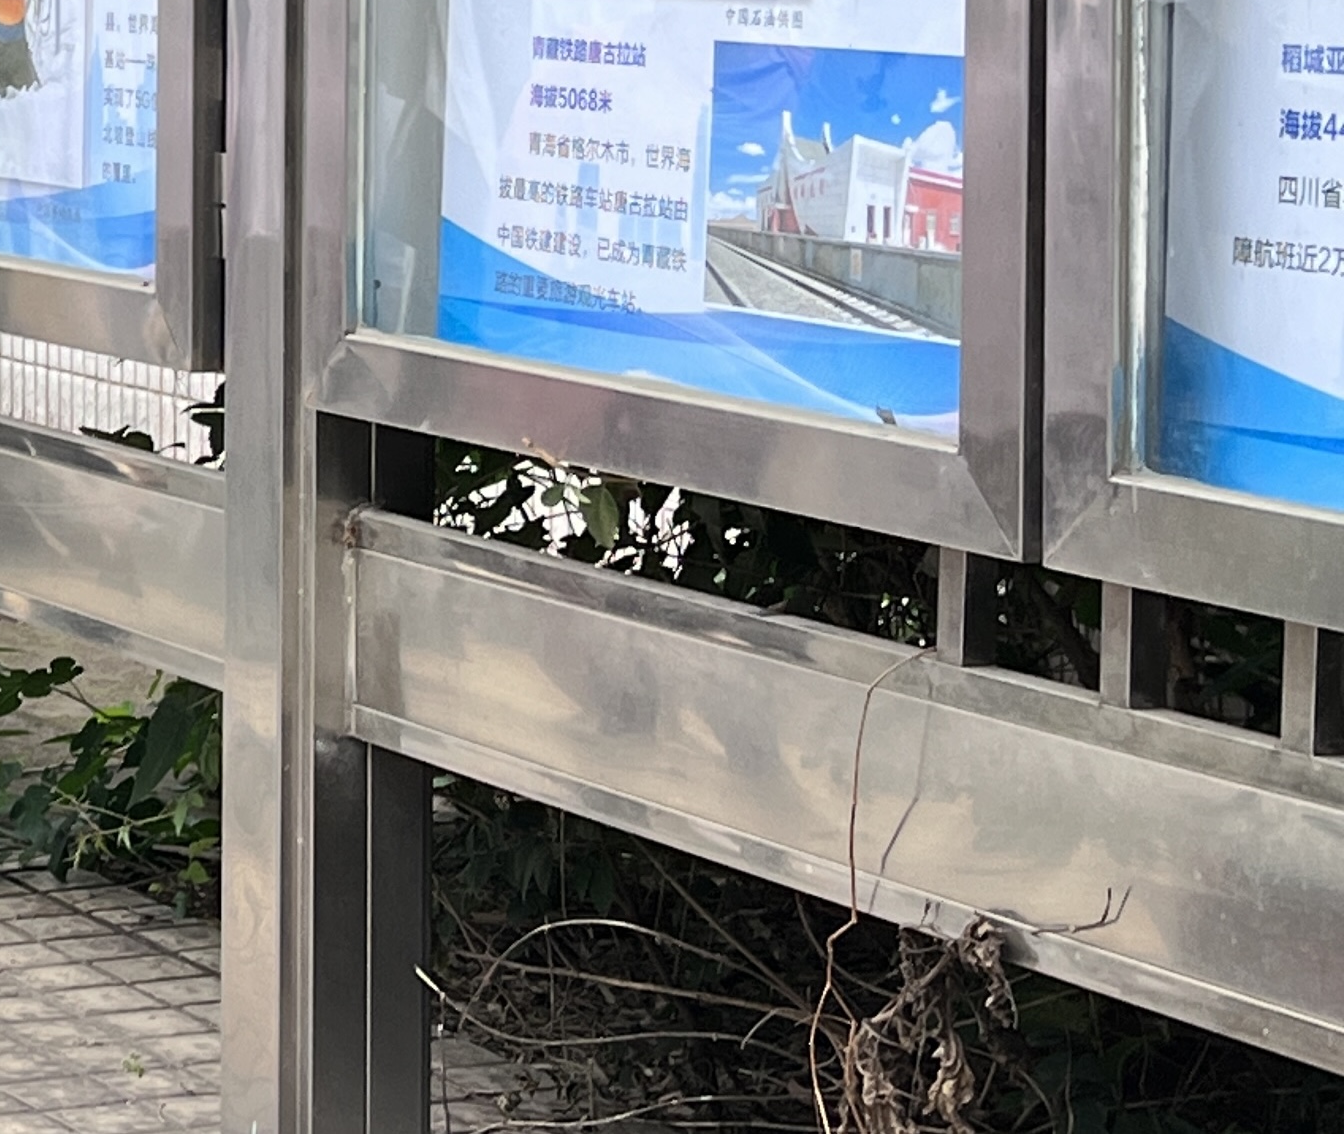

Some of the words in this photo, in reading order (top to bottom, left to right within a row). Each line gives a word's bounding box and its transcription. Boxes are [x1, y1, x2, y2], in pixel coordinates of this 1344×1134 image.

[530, 83, 612, 114] 海拔5068米
[1278, 175, 1344, 209] 四川省
